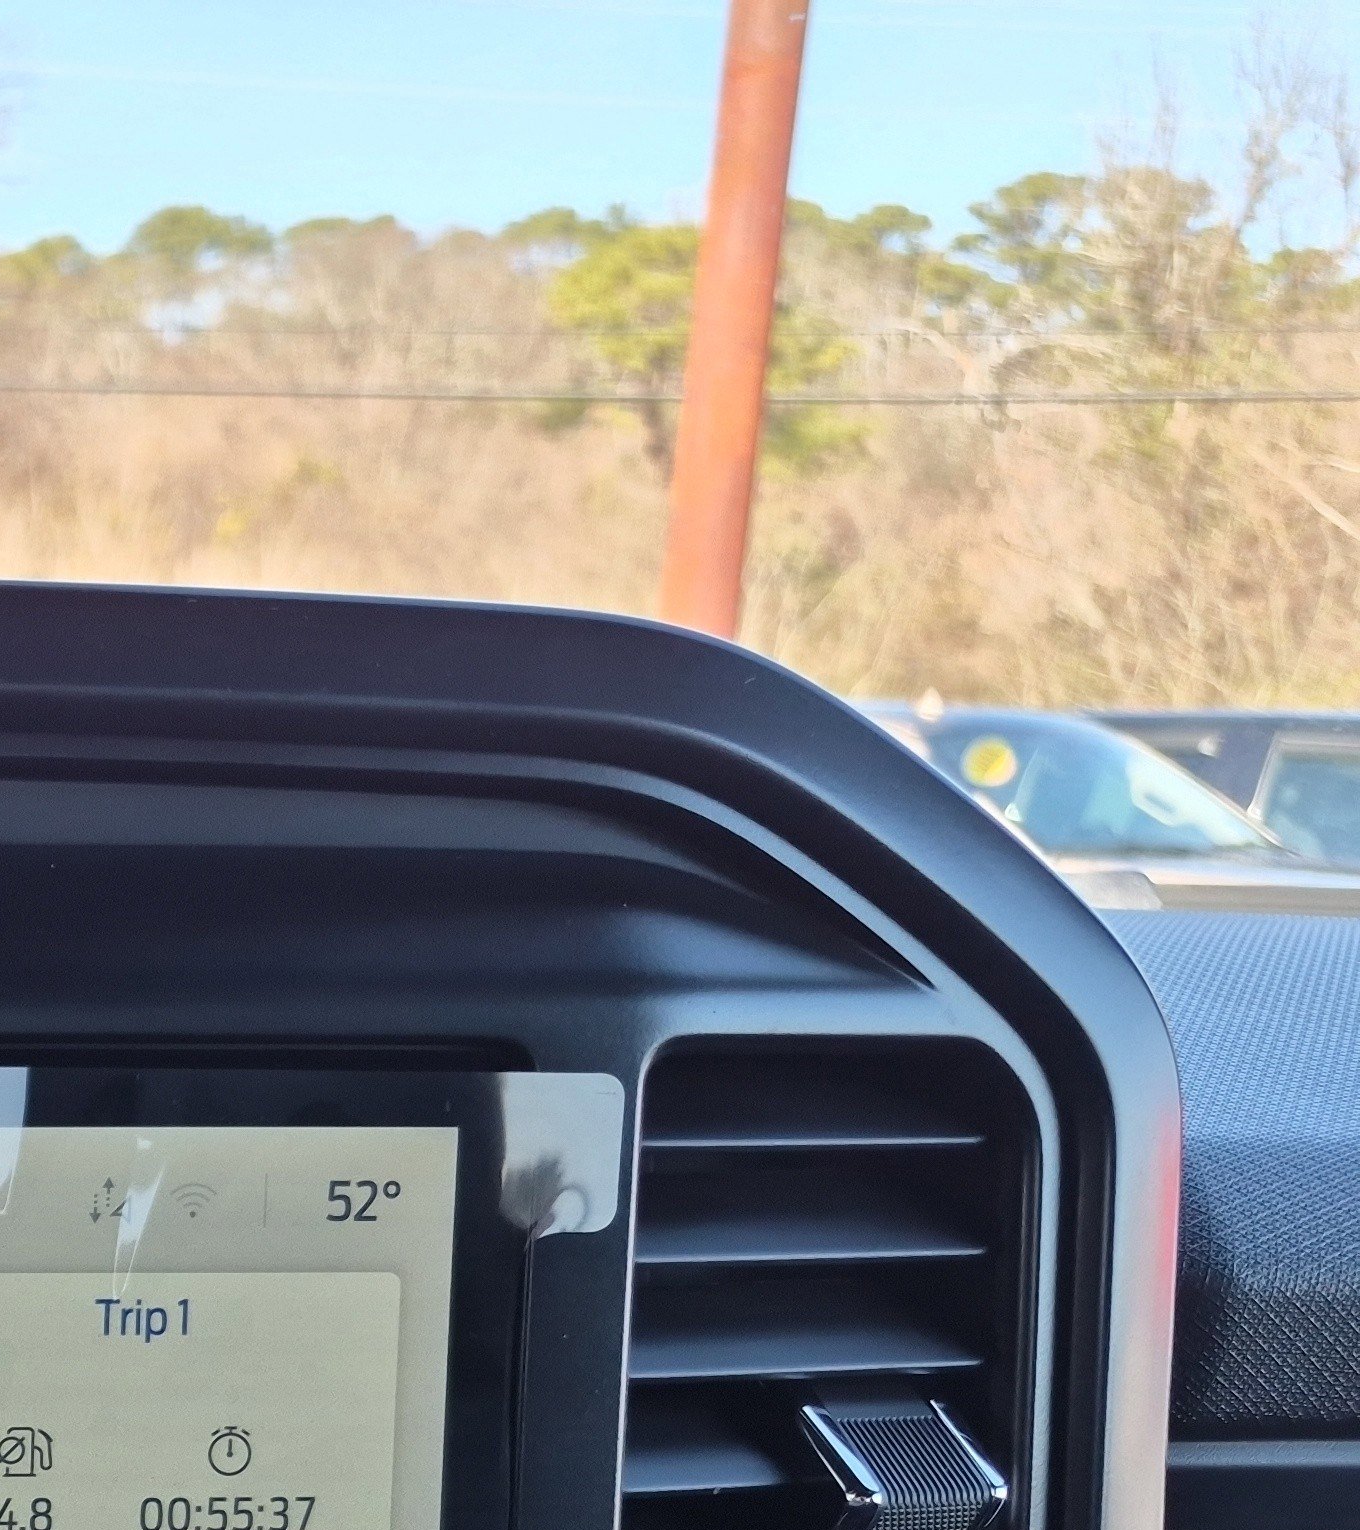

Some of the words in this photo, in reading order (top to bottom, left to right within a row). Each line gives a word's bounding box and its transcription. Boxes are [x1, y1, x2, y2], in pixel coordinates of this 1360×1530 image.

[326, 1180, 401, 1222] 52°
[95, 1299, 168, 1343] Trip
[178, 1299, 191, 1336] 1
